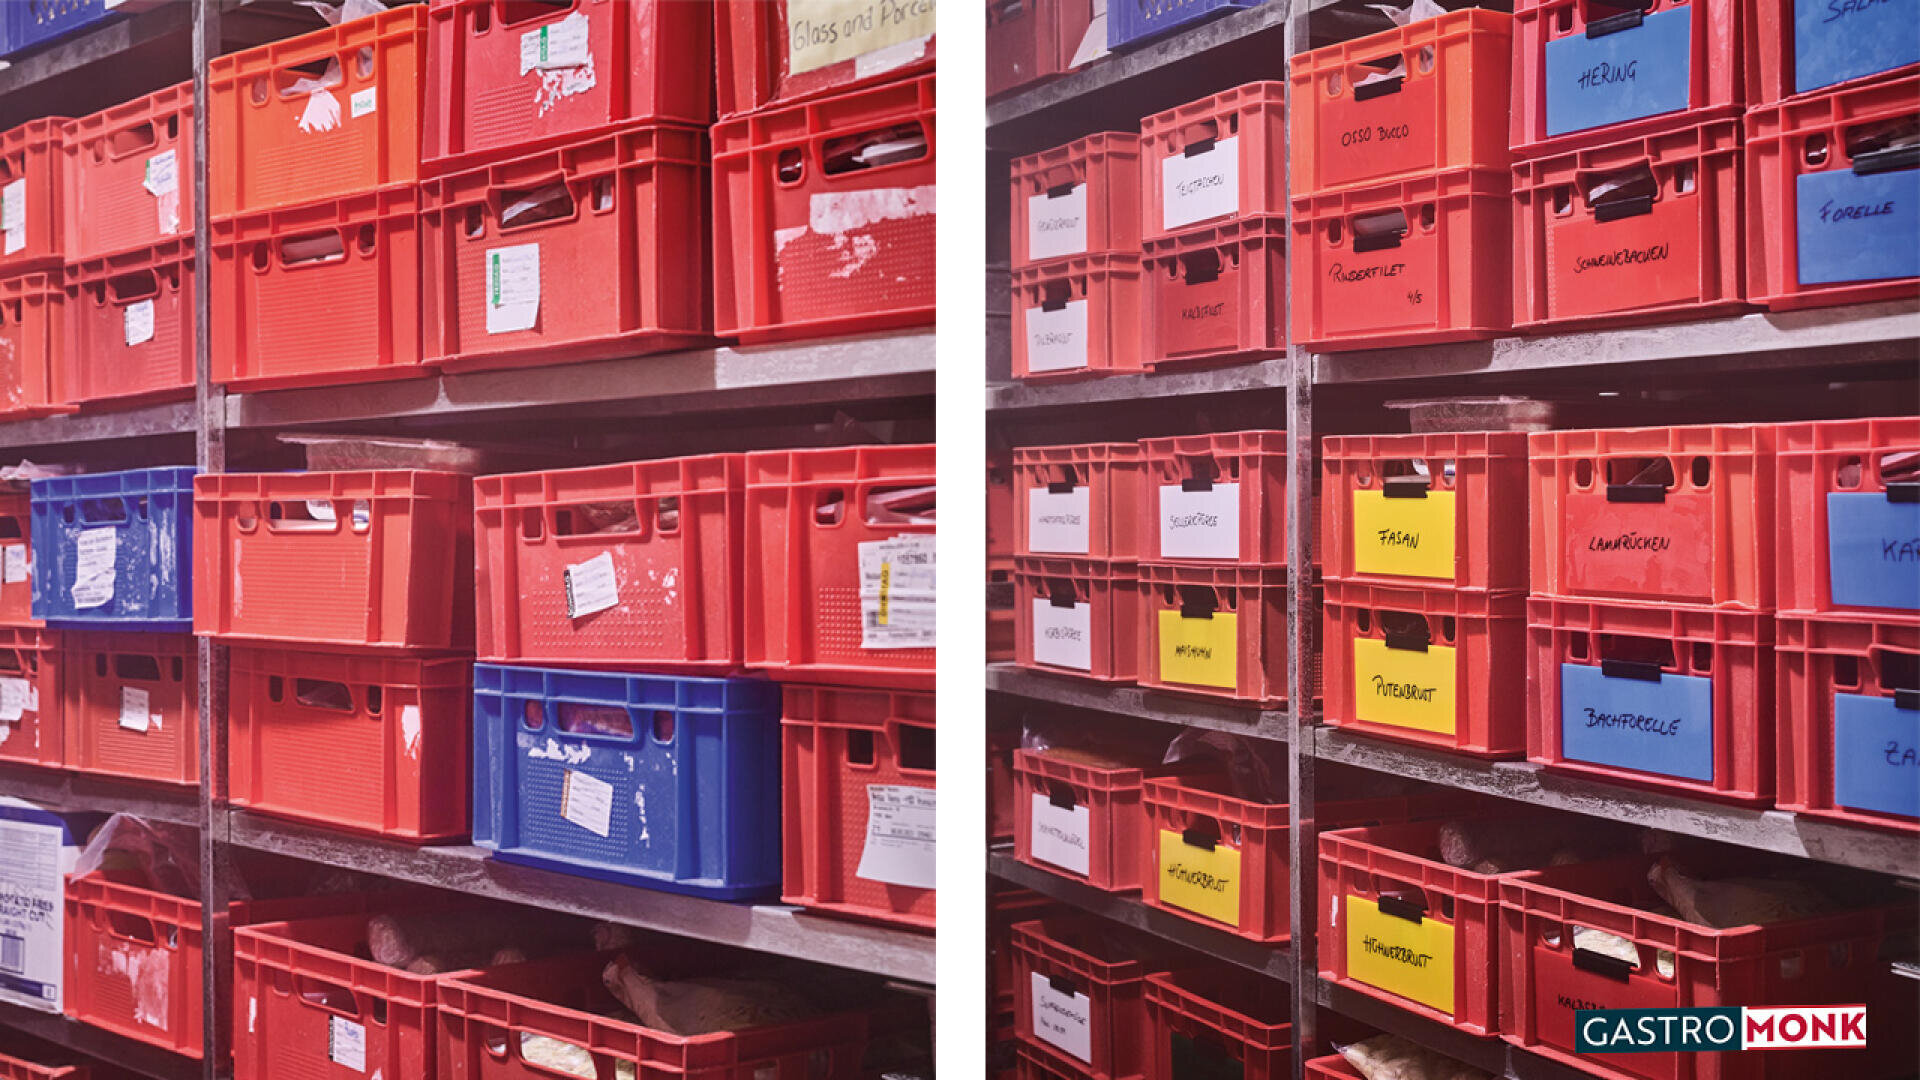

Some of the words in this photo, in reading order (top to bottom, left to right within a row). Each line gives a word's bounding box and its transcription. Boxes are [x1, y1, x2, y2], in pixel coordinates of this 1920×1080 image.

[793, 20, 838, 51] Glass
[843, 5, 873, 38] and
[1578, 60, 1637, 89] HERING
[1341, 127, 1371, 147] OSSO
[1376, 124, 1409, 141] BUCCO
[1819, 200, 1896, 224] FORELLE
[1406, 290, 1423, 305] 4/5
[1377, 529, 1419, 550] FASAN
[1589, 531, 1670, 552] LAMMRÜCKEN
[1372, 674, 1437, 703] PUTENBRUST
[1584, 707, 1681, 736] BACHFORELLE
